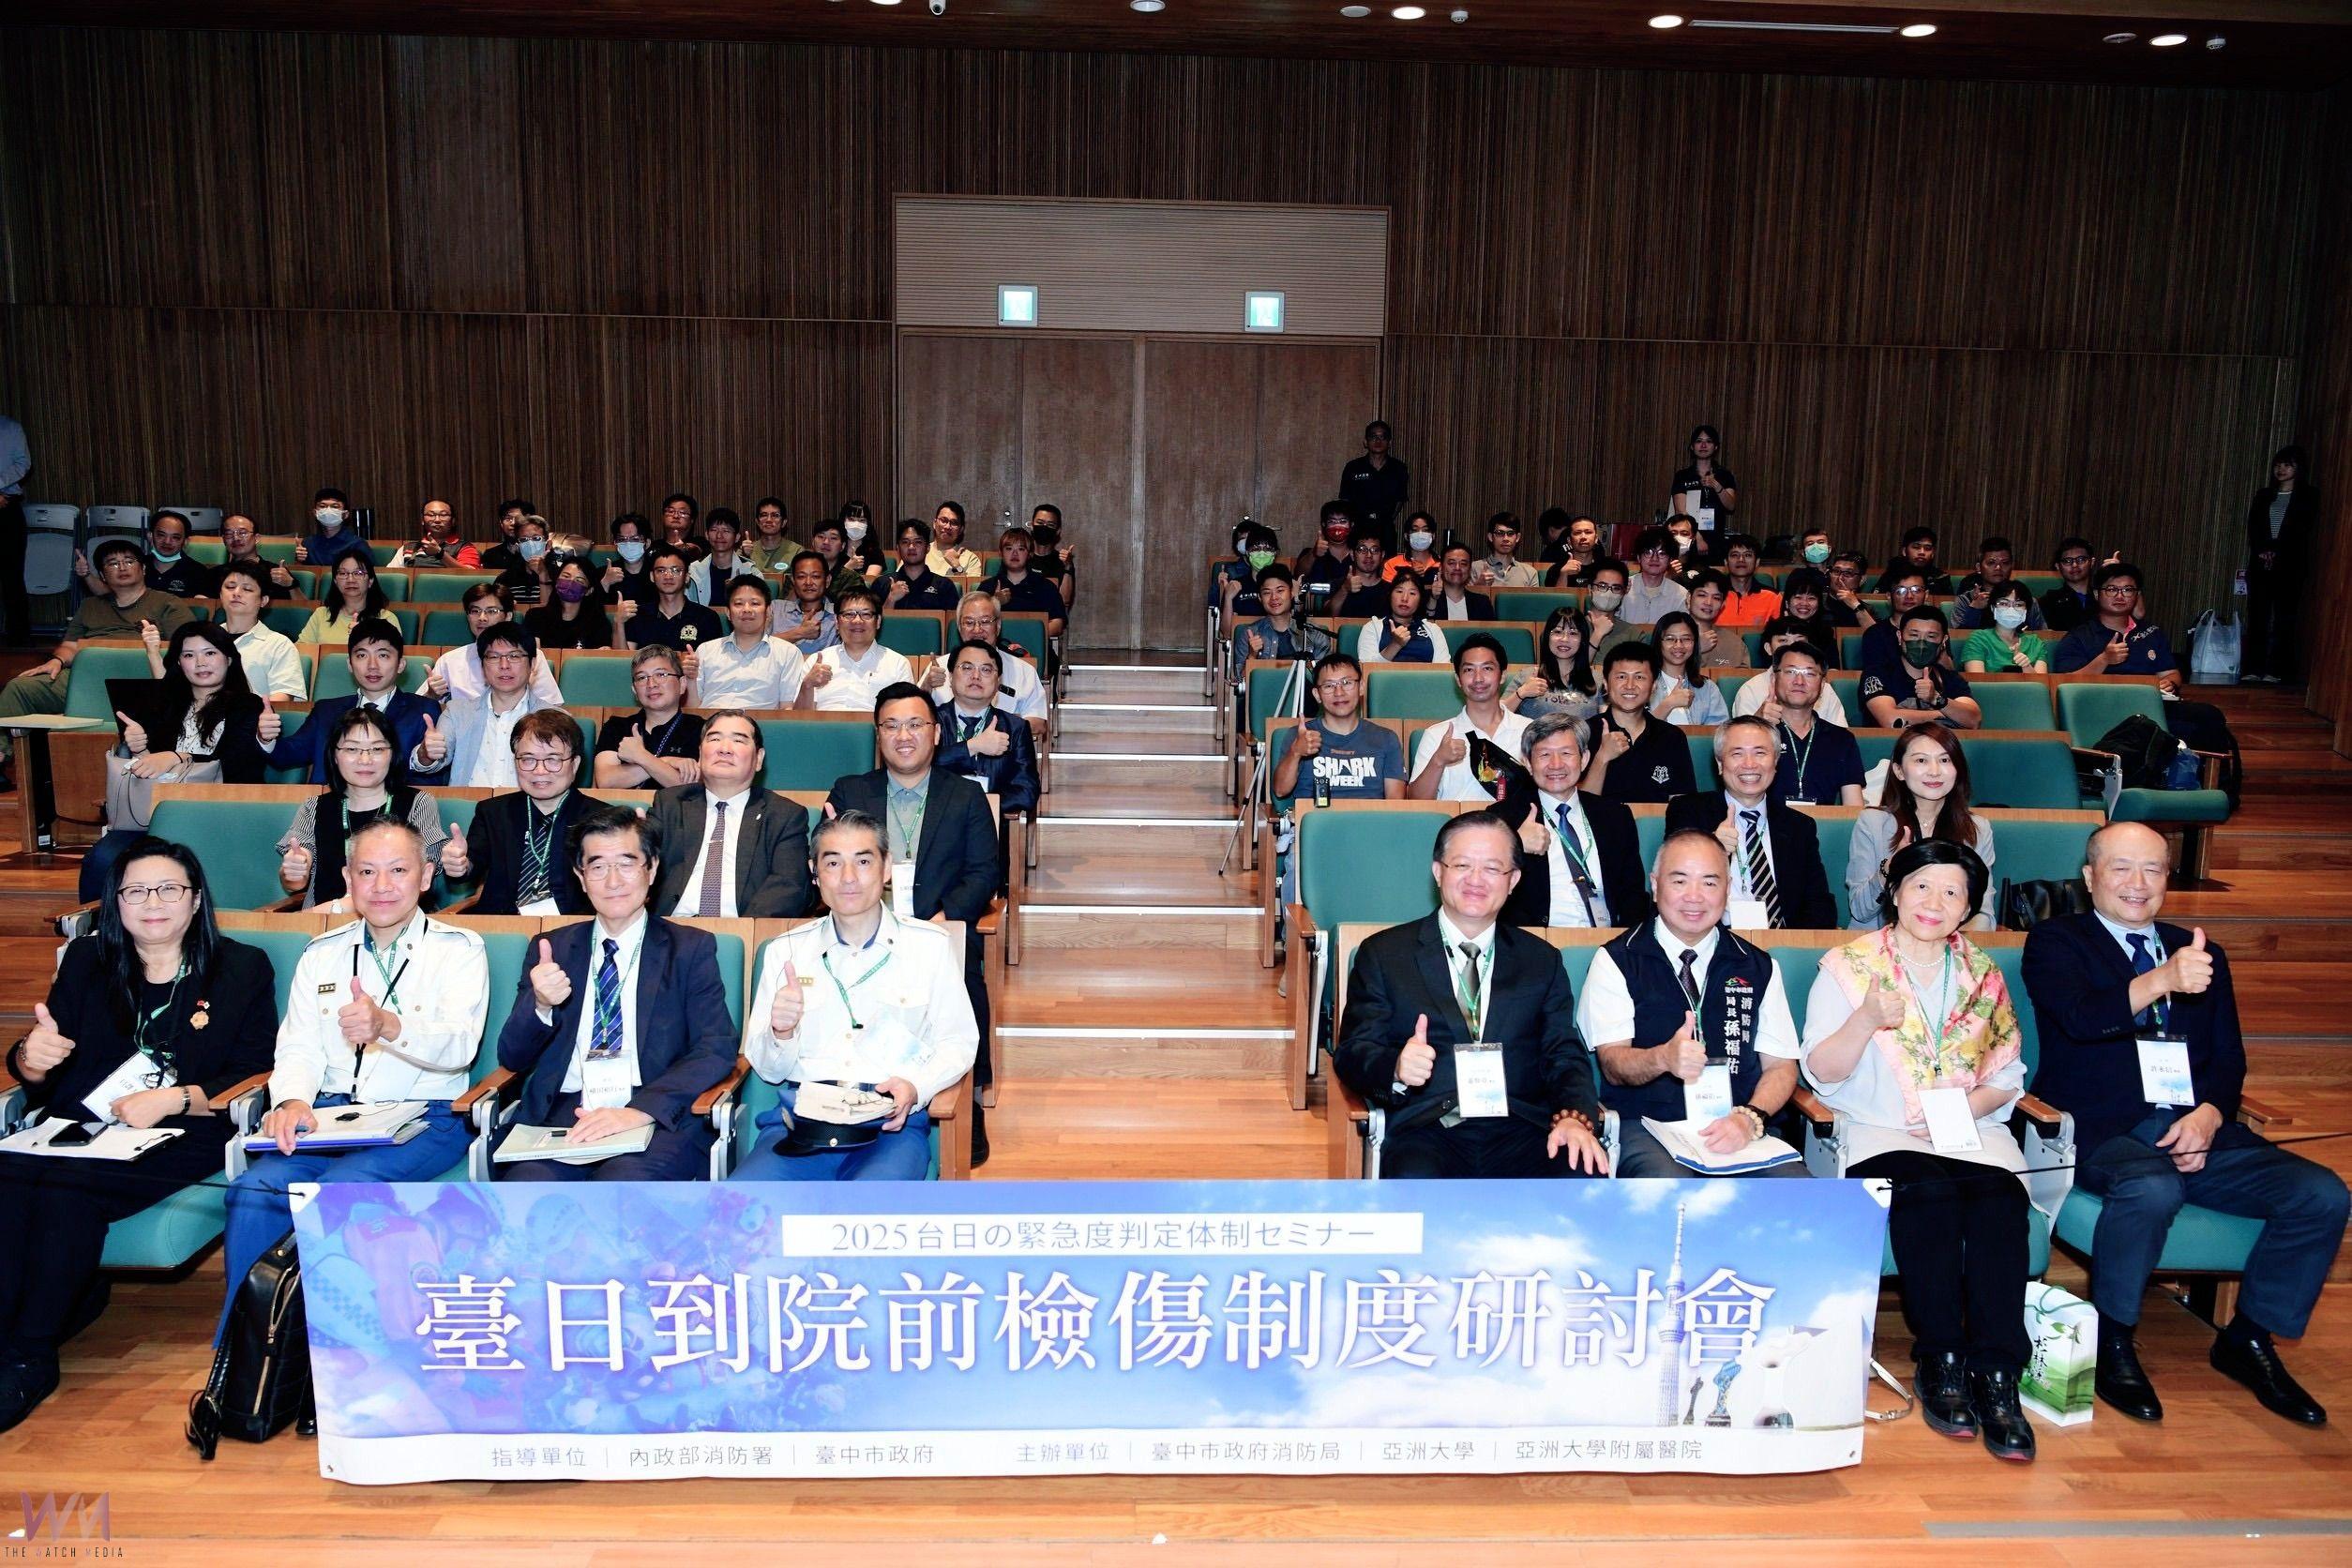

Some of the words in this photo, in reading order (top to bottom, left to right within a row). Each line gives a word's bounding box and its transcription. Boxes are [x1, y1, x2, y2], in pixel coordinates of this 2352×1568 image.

[1313, 756, 1377, 777] SHARK
[1328, 775, 1365, 787] WEEK
[1741, 996, 1754, 1044] 消防局
[415, 1268, 1777, 1374] 臺日到院前檢傷制度研討會
[491, 1447, 586, 1468] 指導單位
[815, 1444, 934, 1465] 臺中市政府
[1017, 1441, 1110, 1463] 主辦單位
[1152, 1441, 1341, 1462] 臺中市政府消防局
[1382, 1440, 1475, 1461] 亞洲大學
[1515, 1440, 1703, 1460] 亞洲大學附屬醫院
